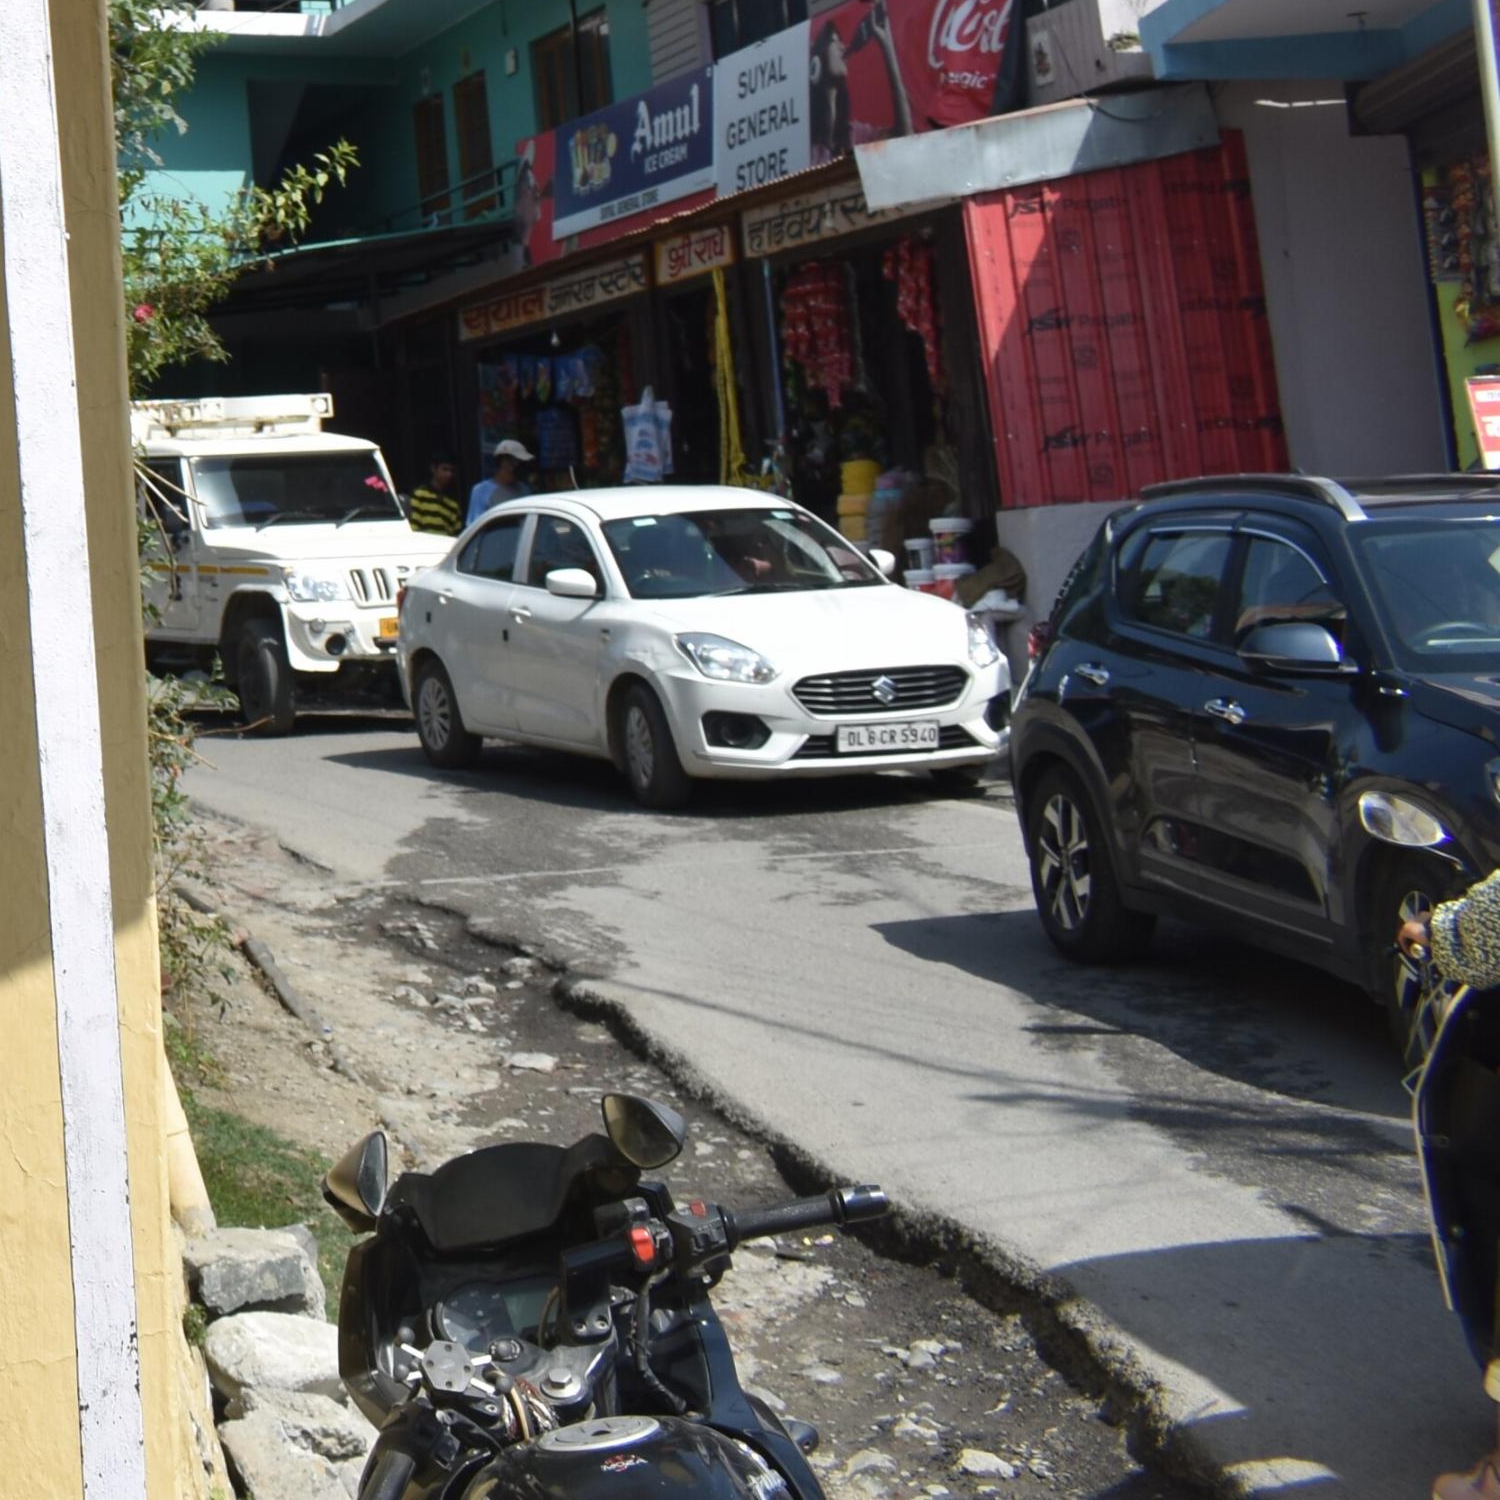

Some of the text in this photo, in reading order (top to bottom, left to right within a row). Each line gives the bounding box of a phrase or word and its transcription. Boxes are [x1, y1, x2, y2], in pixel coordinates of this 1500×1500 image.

[738, 56, 787, 99] SUYAL
[630, 83, 701, 162] Amul
[726, 98, 799, 150] GENERAL
[644, 143, 689, 174] ICE CREAM
[735, 149, 789, 190] STORE
